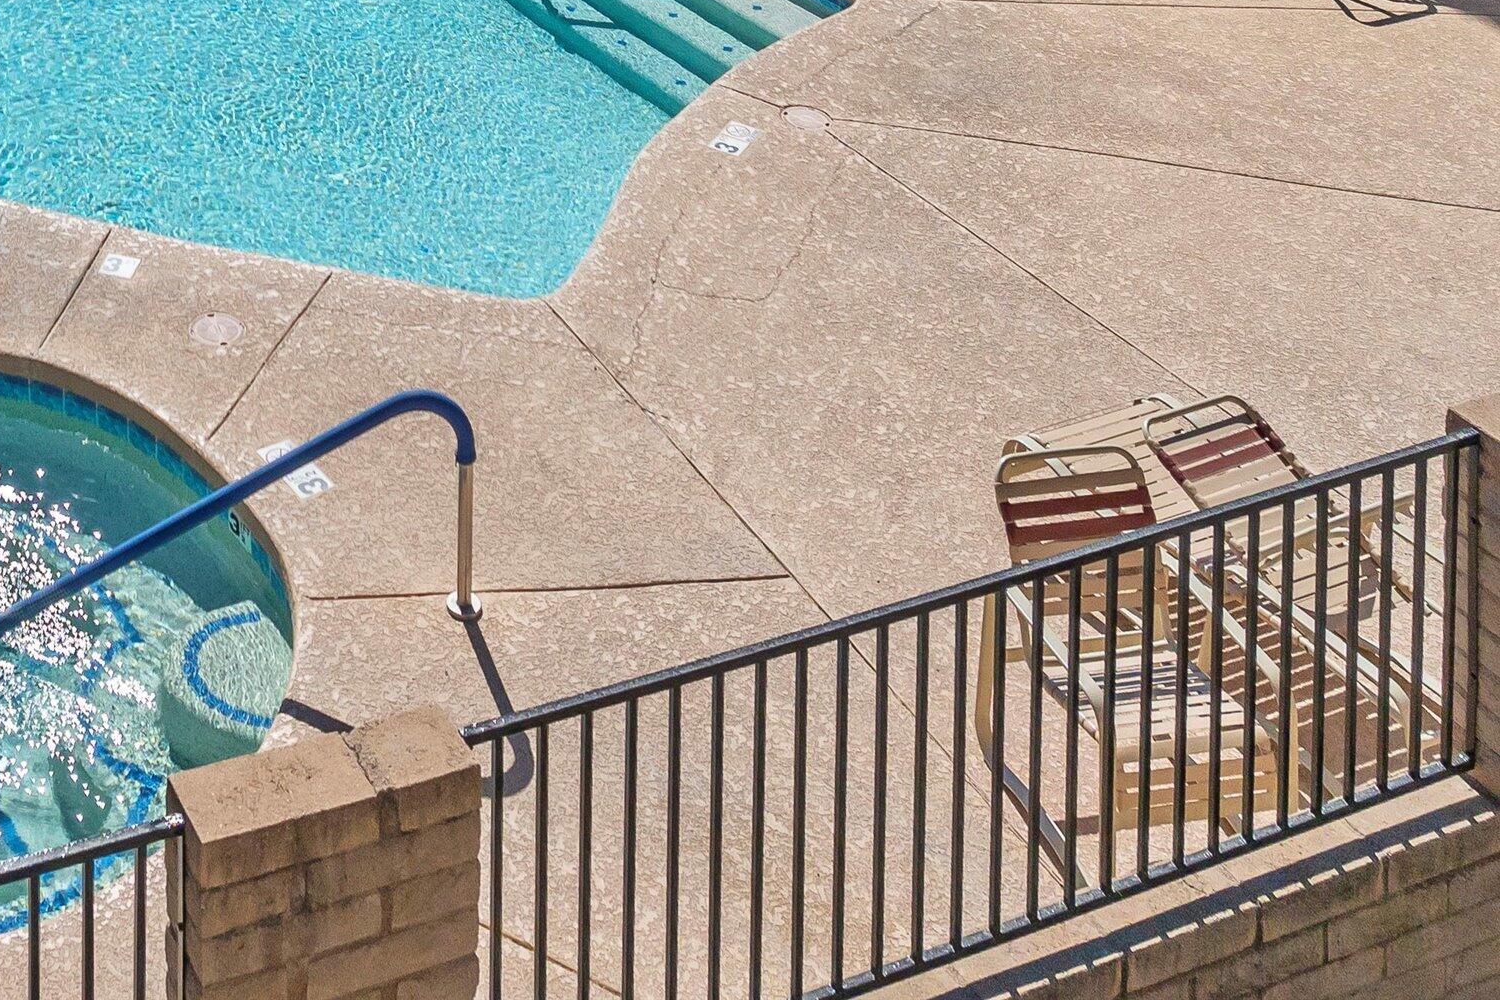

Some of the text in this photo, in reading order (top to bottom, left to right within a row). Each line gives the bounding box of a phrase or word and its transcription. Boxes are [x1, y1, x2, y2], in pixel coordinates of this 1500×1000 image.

[714, 141, 739, 153] 3
[298, 478, 328, 494] 3
[228, 511, 240, 537] 3
